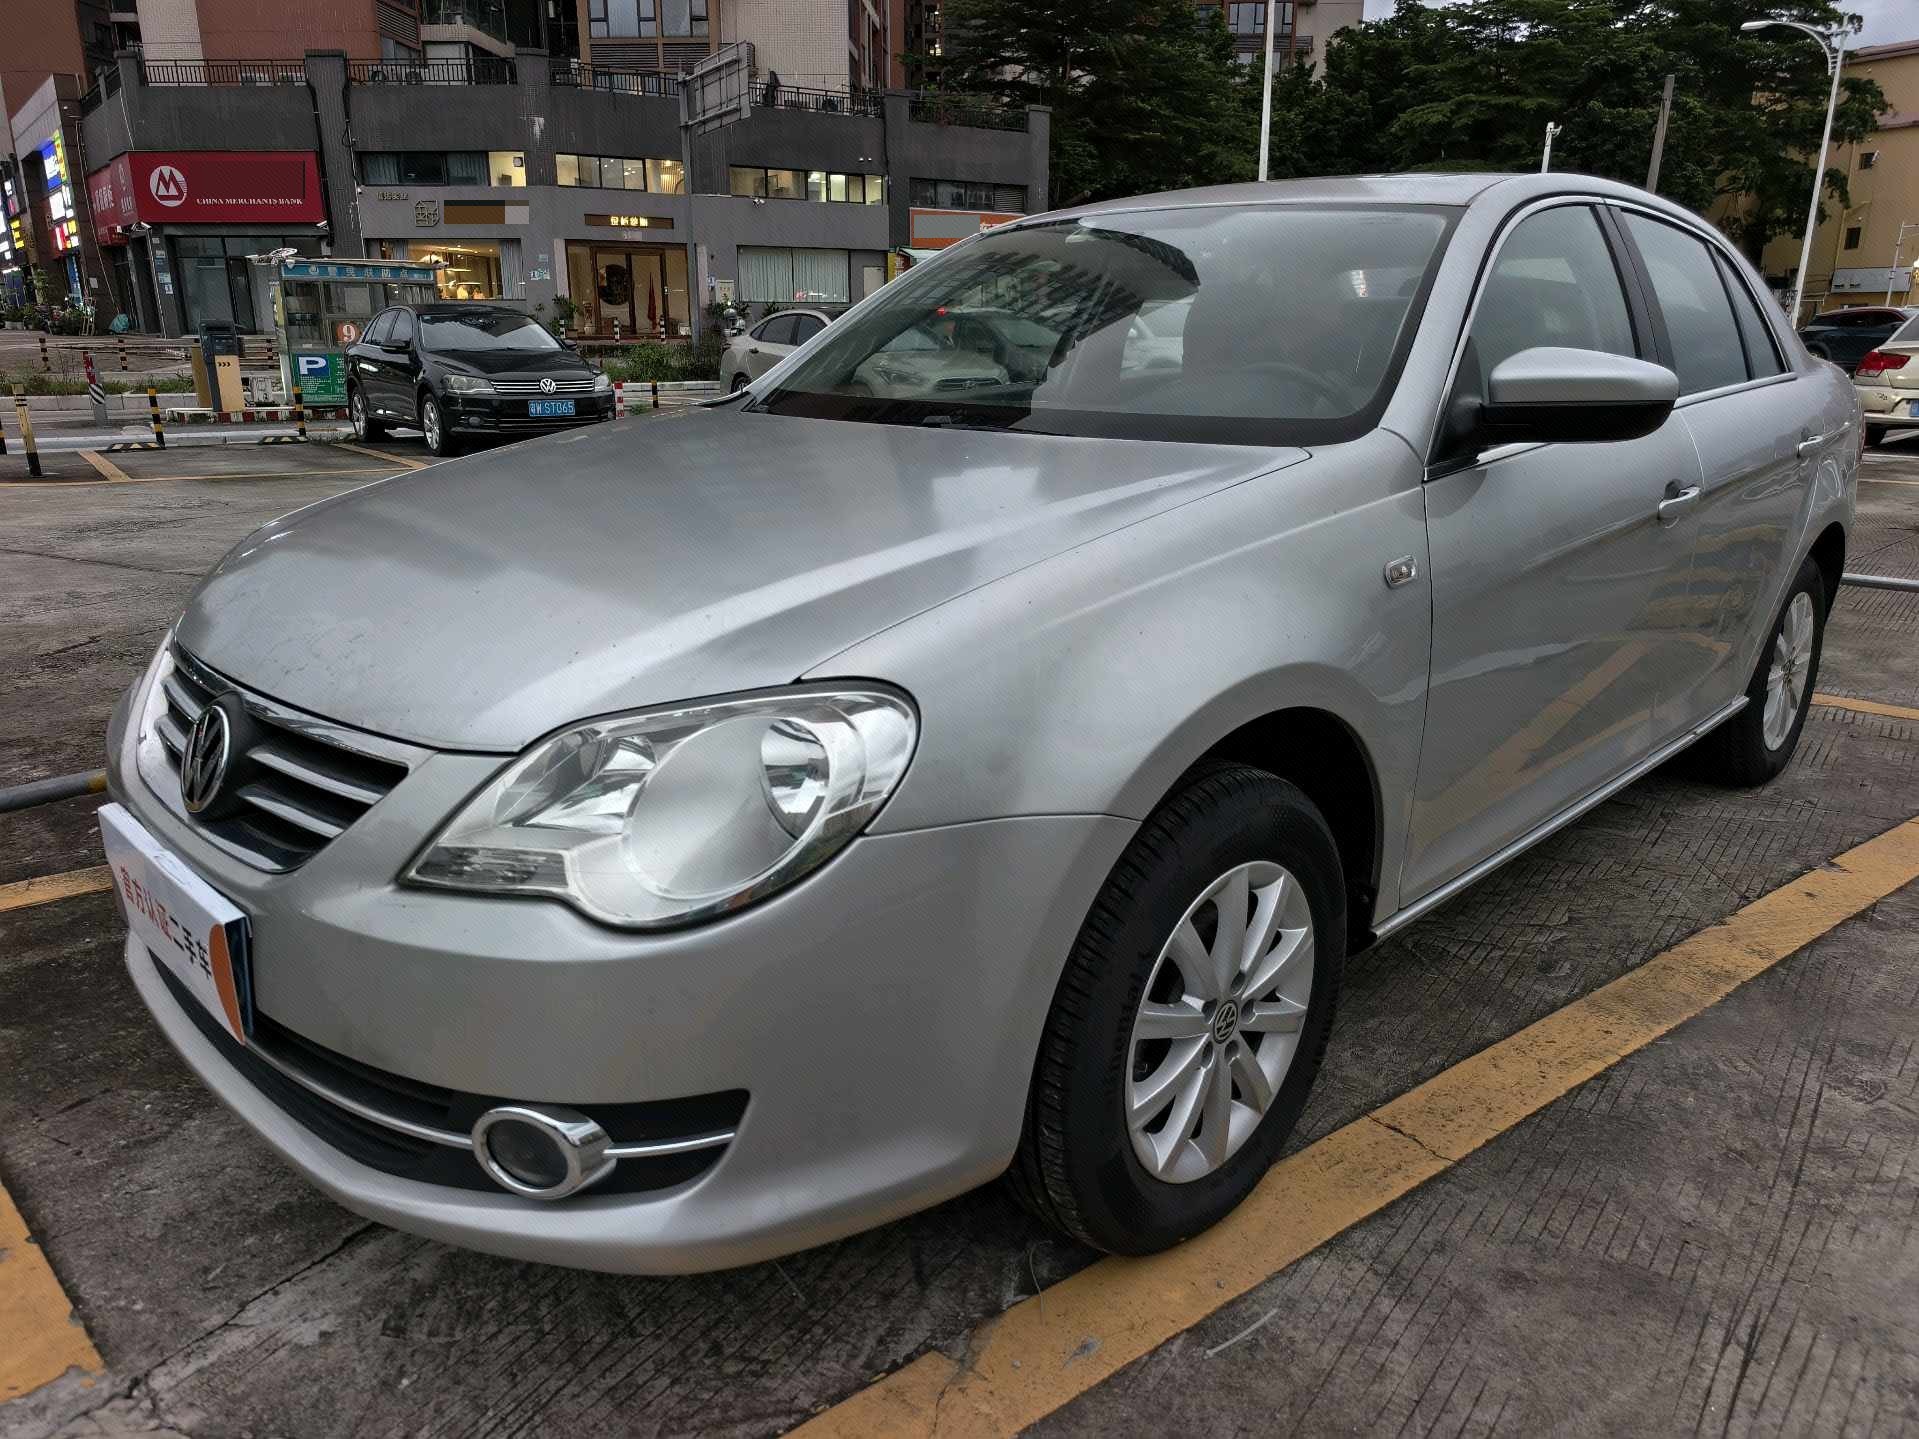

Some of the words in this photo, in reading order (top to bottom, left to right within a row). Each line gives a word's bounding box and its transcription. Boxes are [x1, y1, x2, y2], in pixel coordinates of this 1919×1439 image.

[225, 198, 277, 206] MERCHANTS
[278, 198, 303, 206] BANK
[298, 356, 327, 375] P
